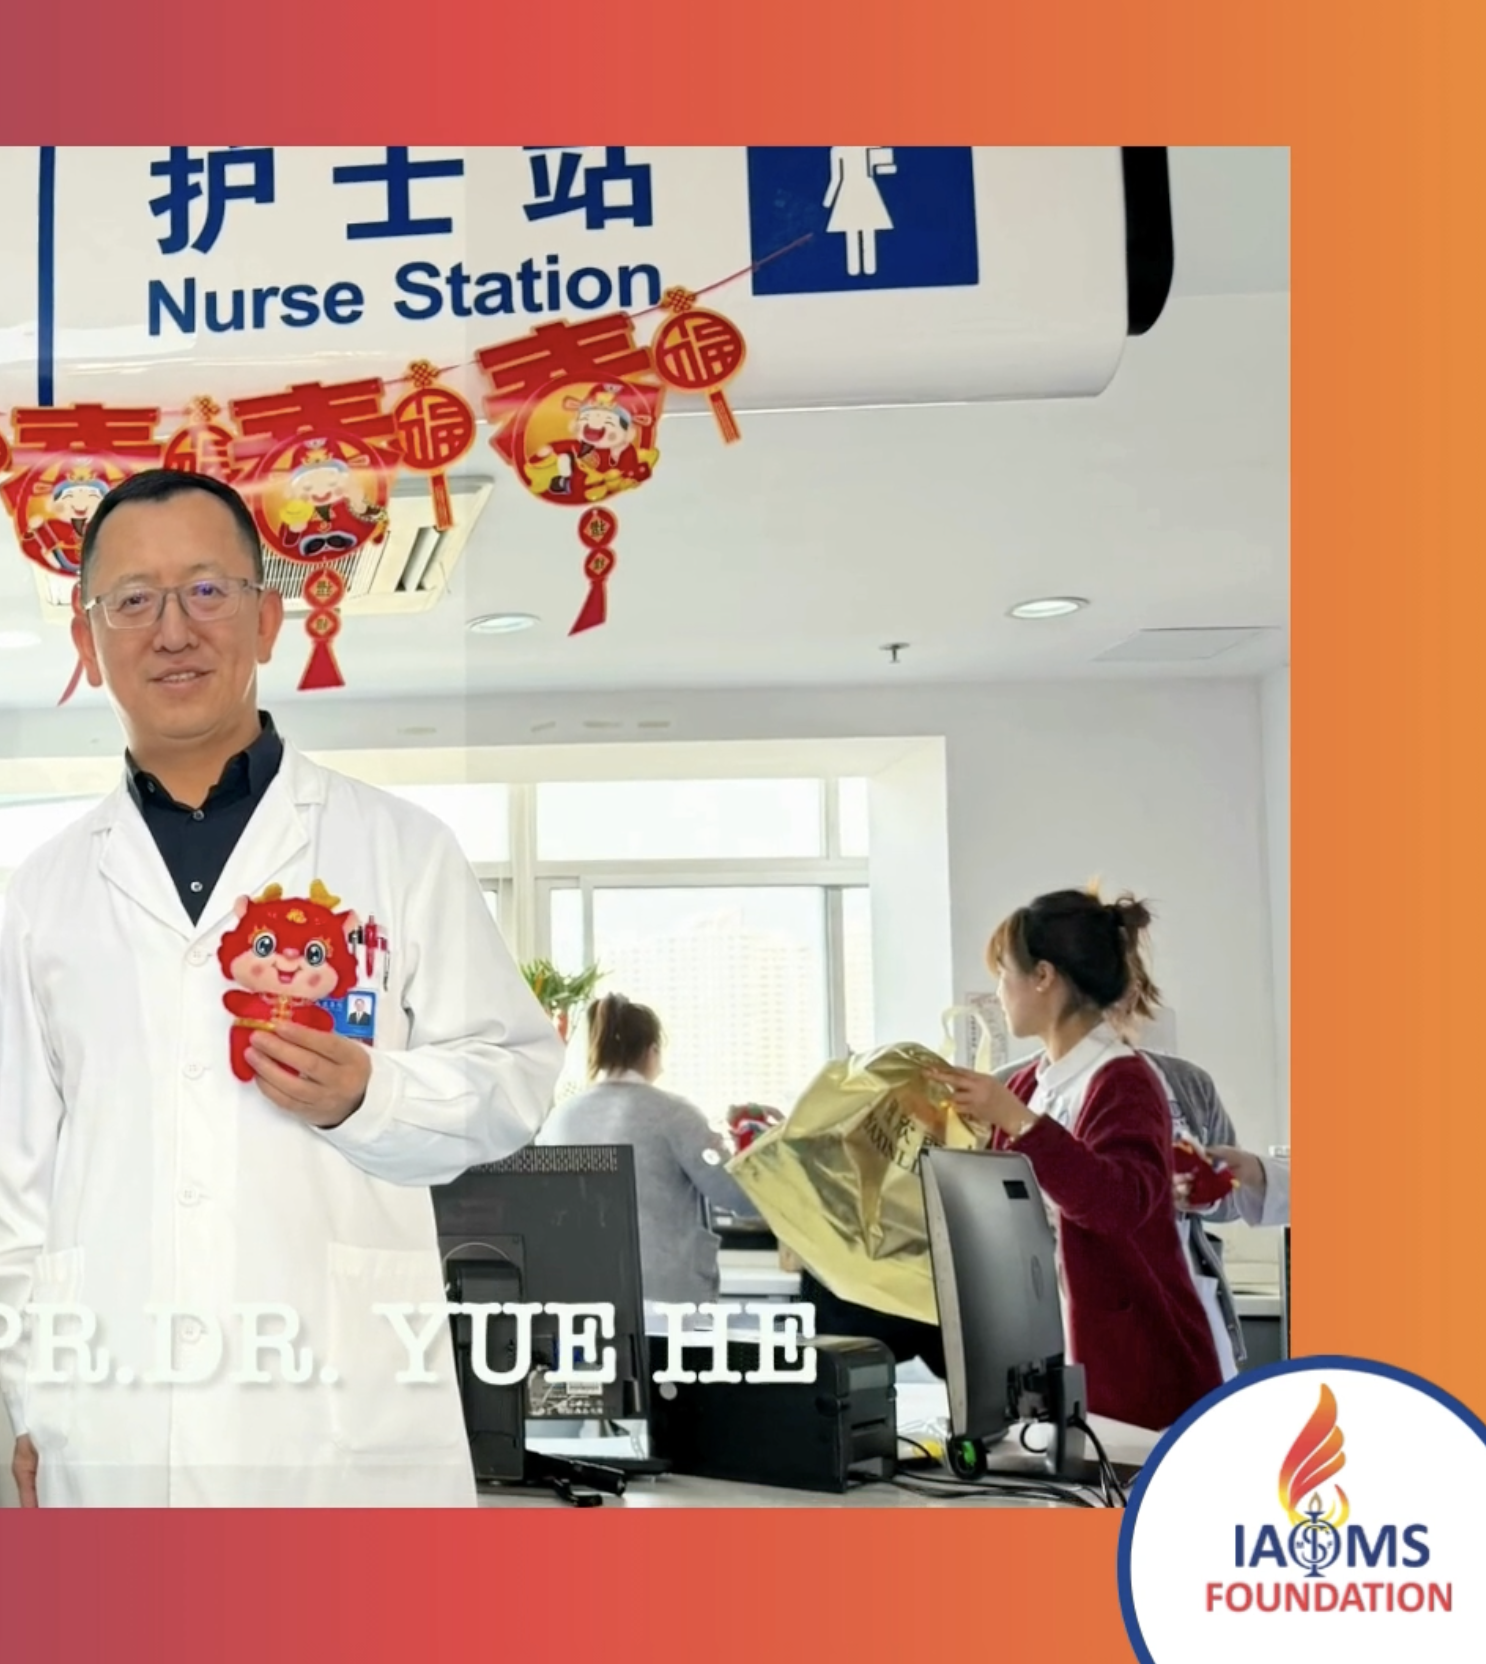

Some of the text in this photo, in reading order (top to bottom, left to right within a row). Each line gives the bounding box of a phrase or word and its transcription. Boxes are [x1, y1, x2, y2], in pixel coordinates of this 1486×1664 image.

[149, 146, 653, 255] 护士站
[148, 254, 661, 336] Nurse Station
[394, 386, 476, 470] 福
[654, 309, 746, 392] 福
